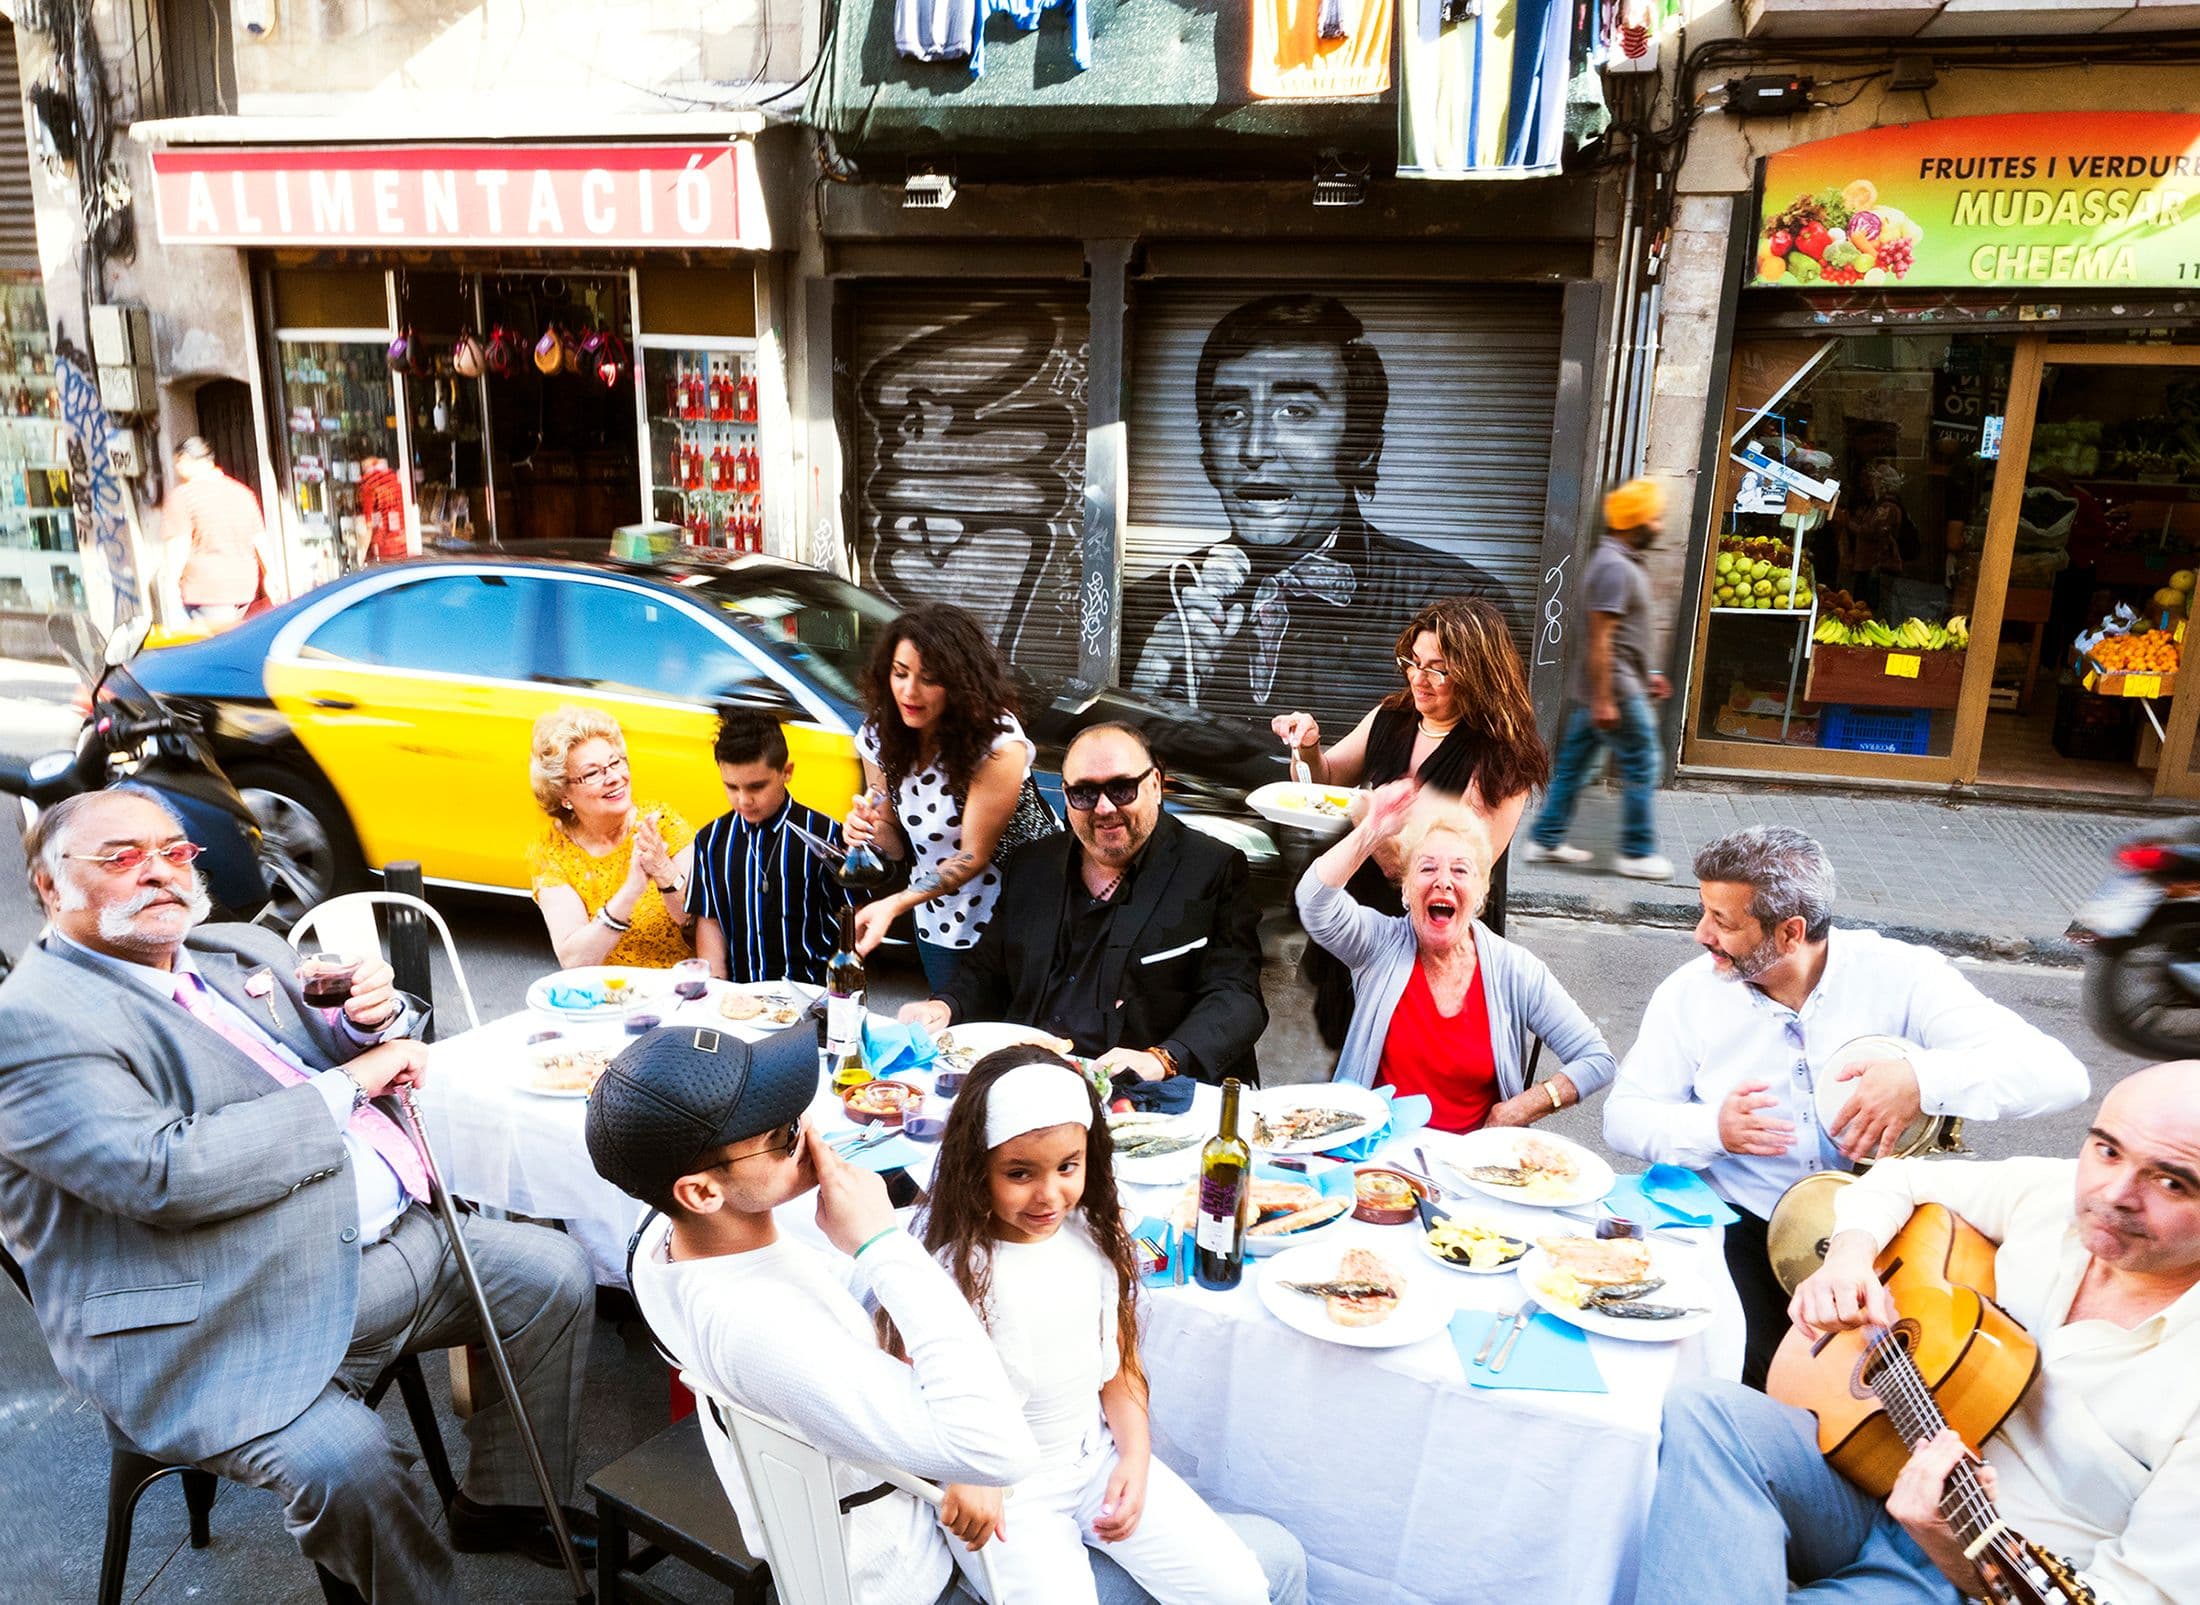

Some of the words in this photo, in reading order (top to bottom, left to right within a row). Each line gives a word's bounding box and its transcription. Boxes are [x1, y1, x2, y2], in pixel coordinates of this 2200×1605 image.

[1919, 156, 2037, 180] FRUITES
[2047, 156, 2056, 179] I
[187, 153, 712, 234] ALIMENTACIÓ
[1952, 188, 2188, 227] MUDASSAR
[1970, 244, 2139, 281] CHEEMA
